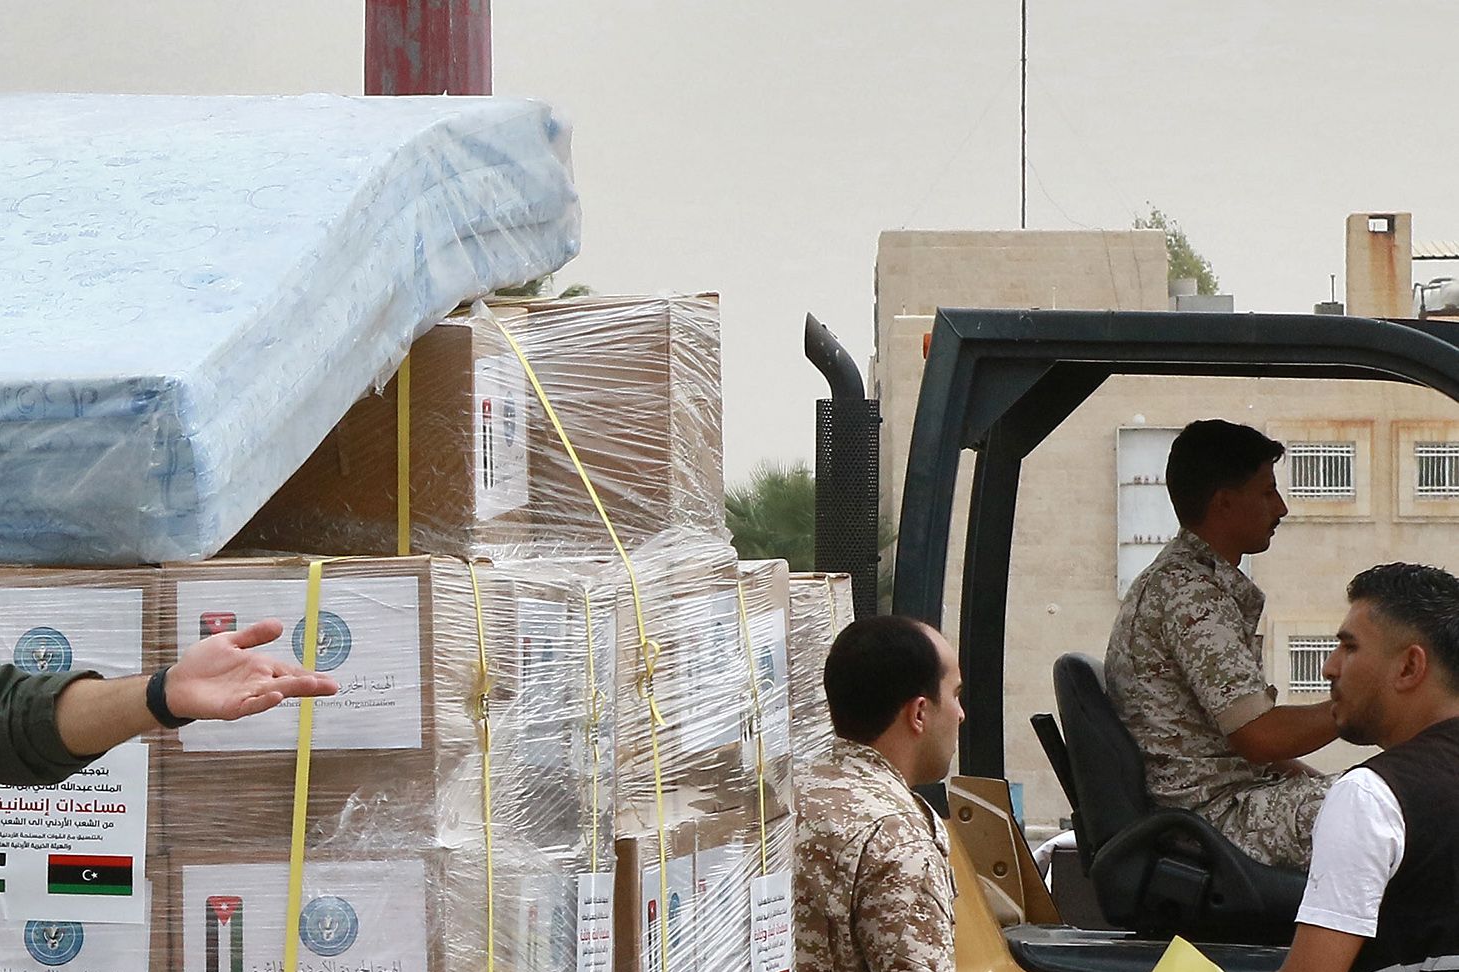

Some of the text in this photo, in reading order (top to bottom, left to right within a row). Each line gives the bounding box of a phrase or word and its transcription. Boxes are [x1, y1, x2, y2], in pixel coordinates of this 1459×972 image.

[344, 699, 396, 710] Organization
[94, 782, 122, 793] الملك
[56, 798, 127, 814] مساعدات
[0, 816, 27, 828] الشعب
[45, 817, 73, 829] الأردني
[74, 817, 101, 828] الشعب
[101, 820, 115, 829] من
